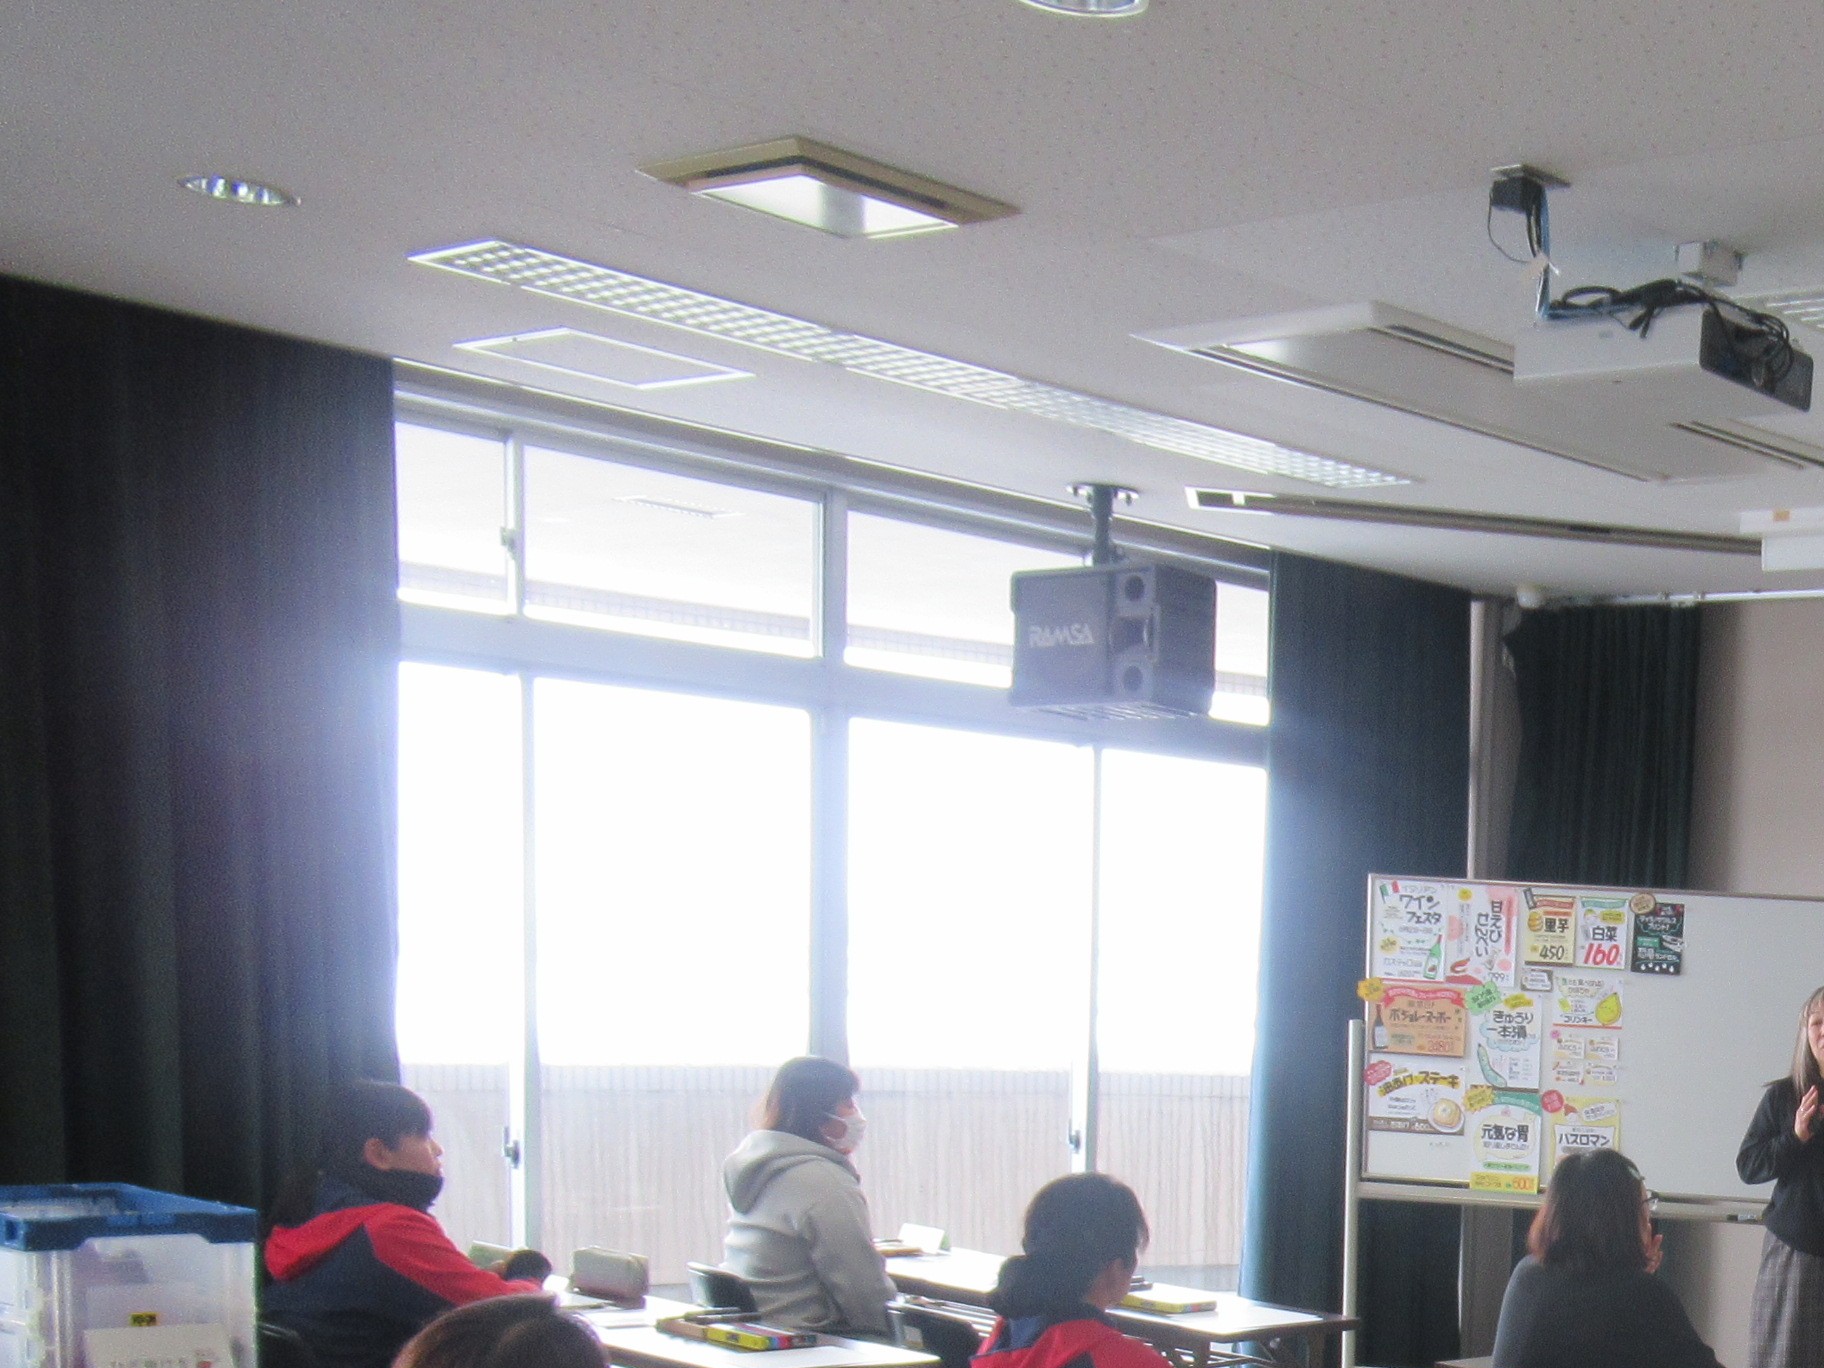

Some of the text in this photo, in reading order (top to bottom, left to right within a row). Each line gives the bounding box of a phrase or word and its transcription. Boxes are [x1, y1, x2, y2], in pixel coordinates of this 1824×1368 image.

[1406, 911, 1442, 925] フェスタ
[1592, 925, 1617, 942] 白菜
[1583, 942, 1621, 966] 160
[1492, 1010, 1534, 1024] きゅうり
